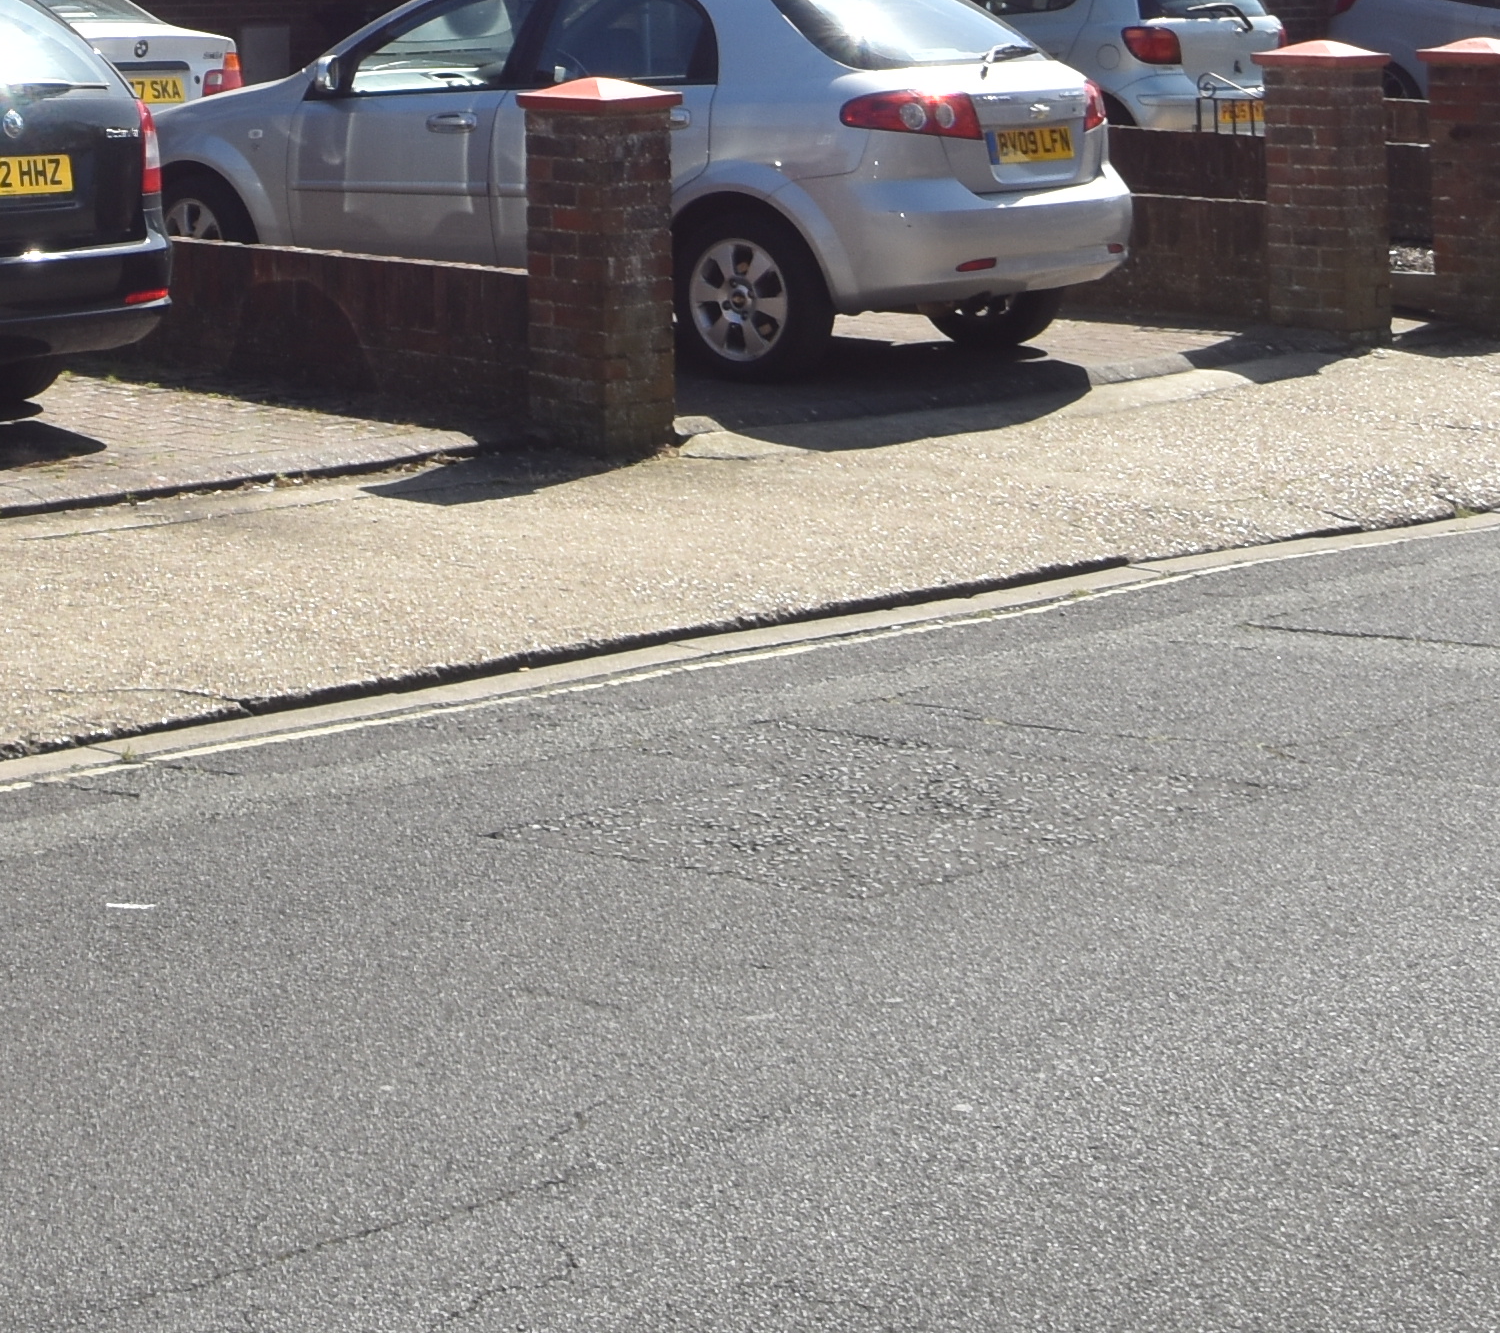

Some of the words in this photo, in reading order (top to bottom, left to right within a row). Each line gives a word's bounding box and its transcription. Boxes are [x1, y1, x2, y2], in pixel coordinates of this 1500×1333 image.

[150, 80, 182, 99] SKA
[1040, 127, 1071, 153] LFN
[18, 158, 63, 187] HHZ
